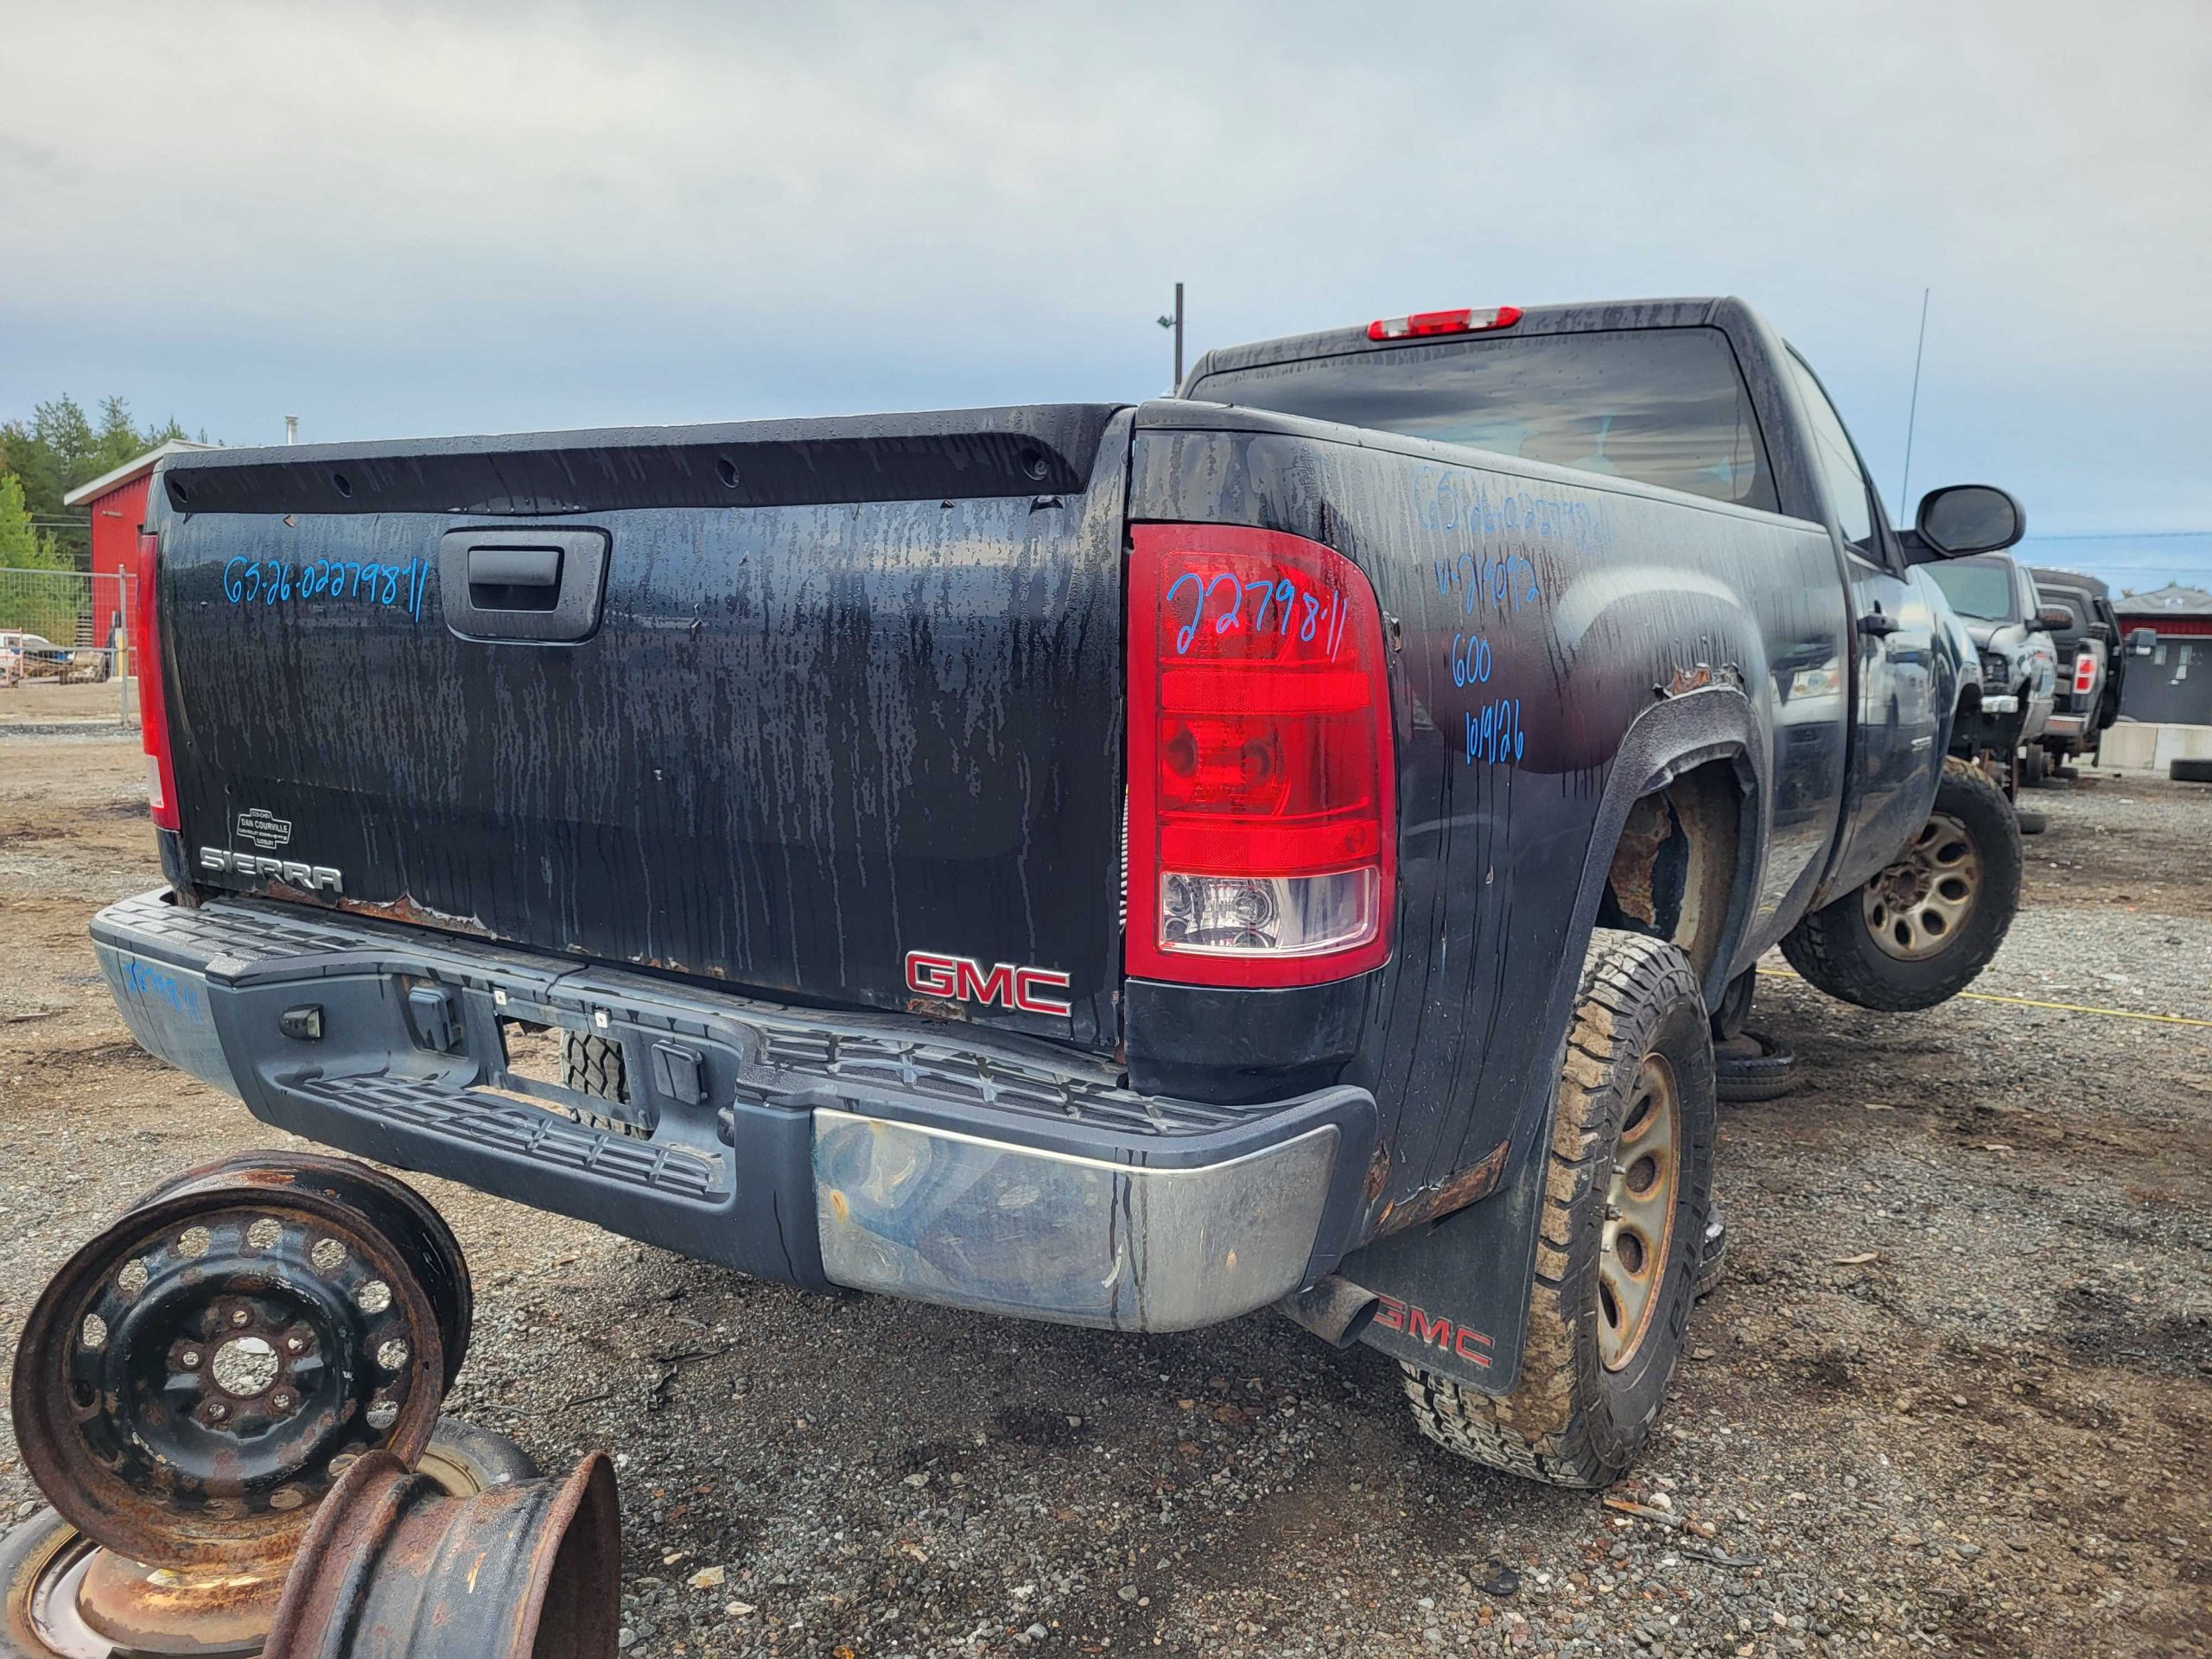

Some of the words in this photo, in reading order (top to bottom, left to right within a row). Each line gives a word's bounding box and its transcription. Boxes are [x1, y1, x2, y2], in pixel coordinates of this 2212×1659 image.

[1452, 632, 1492, 688] 600
[241, 817, 254, 827] DAN
[254, 820, 289, 834] COURVILLE
[200, 846, 343, 893] SIERRA
[905, 950, 1072, 1018] GMC
[1373, 1294, 1496, 1369] GMC
